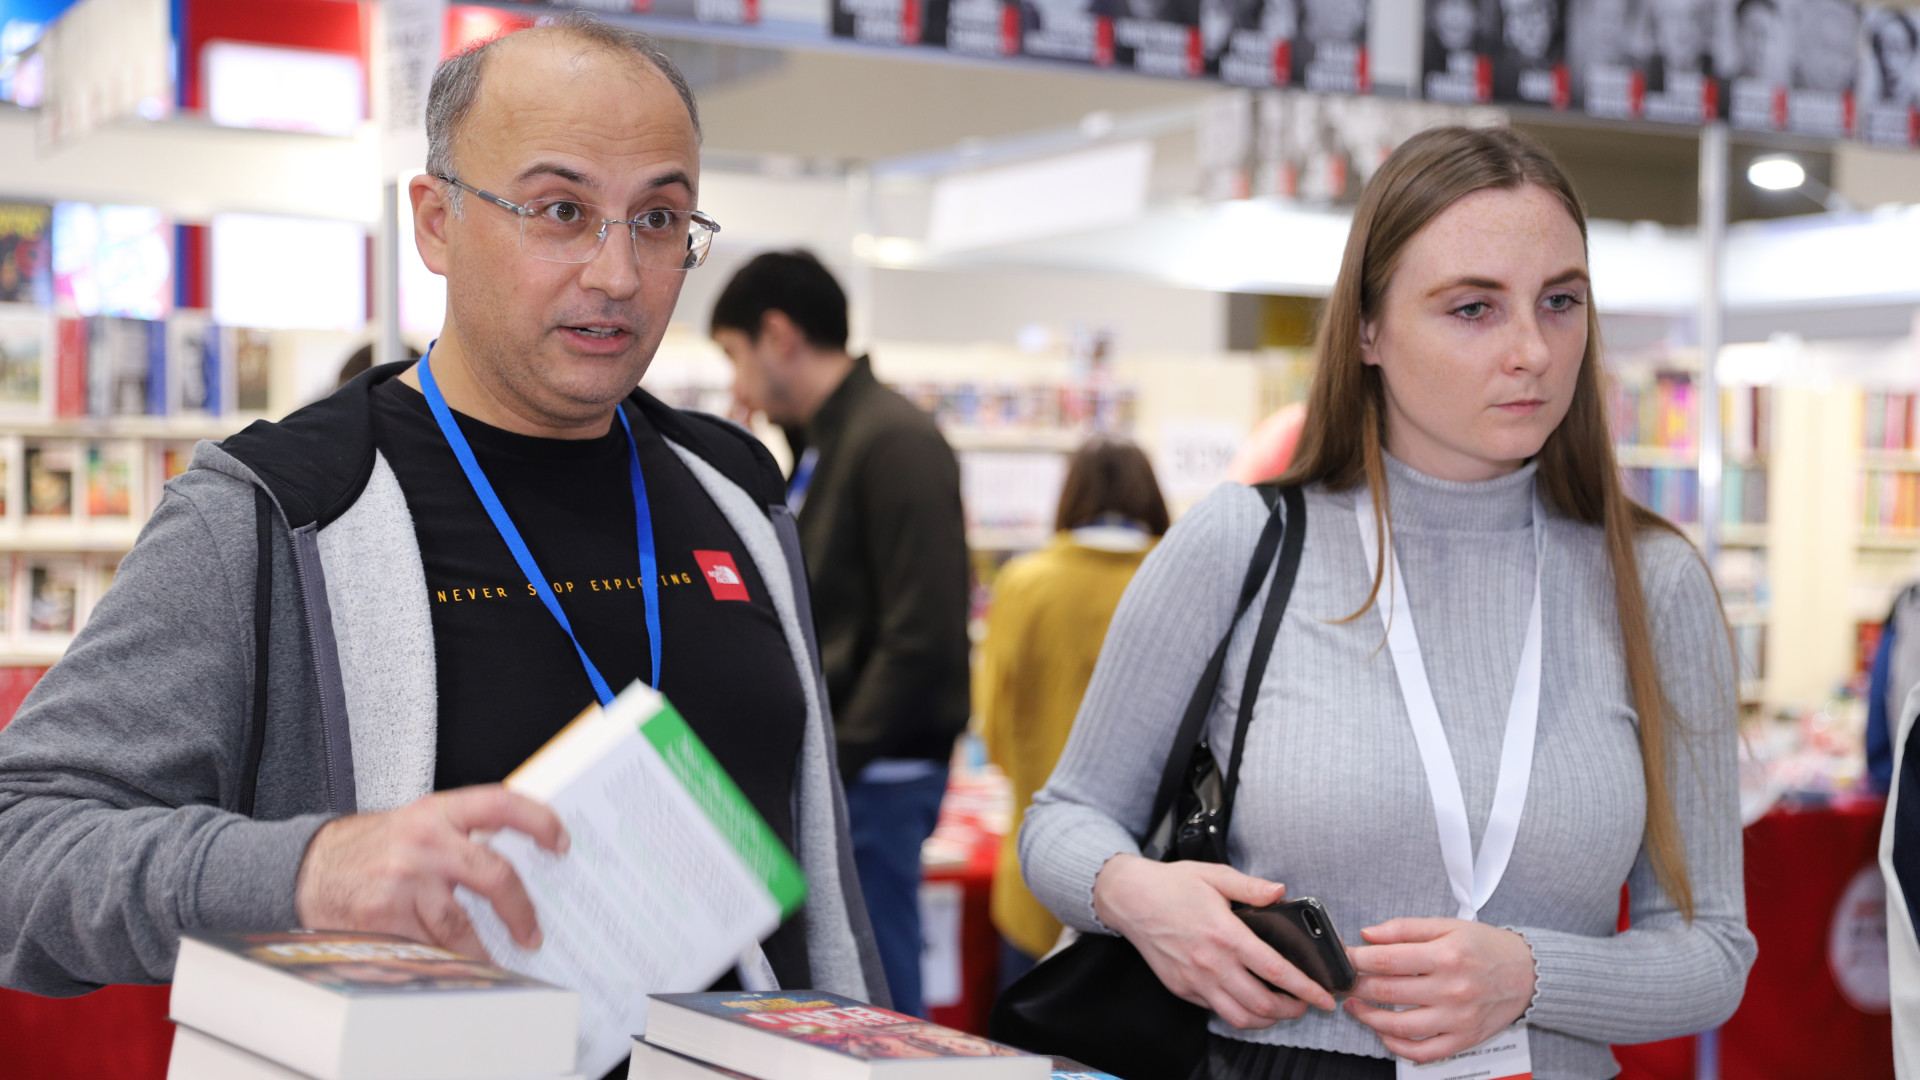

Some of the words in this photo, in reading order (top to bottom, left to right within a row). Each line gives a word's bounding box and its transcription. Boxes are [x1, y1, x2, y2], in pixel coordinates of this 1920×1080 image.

[437, 587, 508, 602] NEVER
[527, 582, 574, 596] SOP
[590, 572, 692, 591] EXPLING
